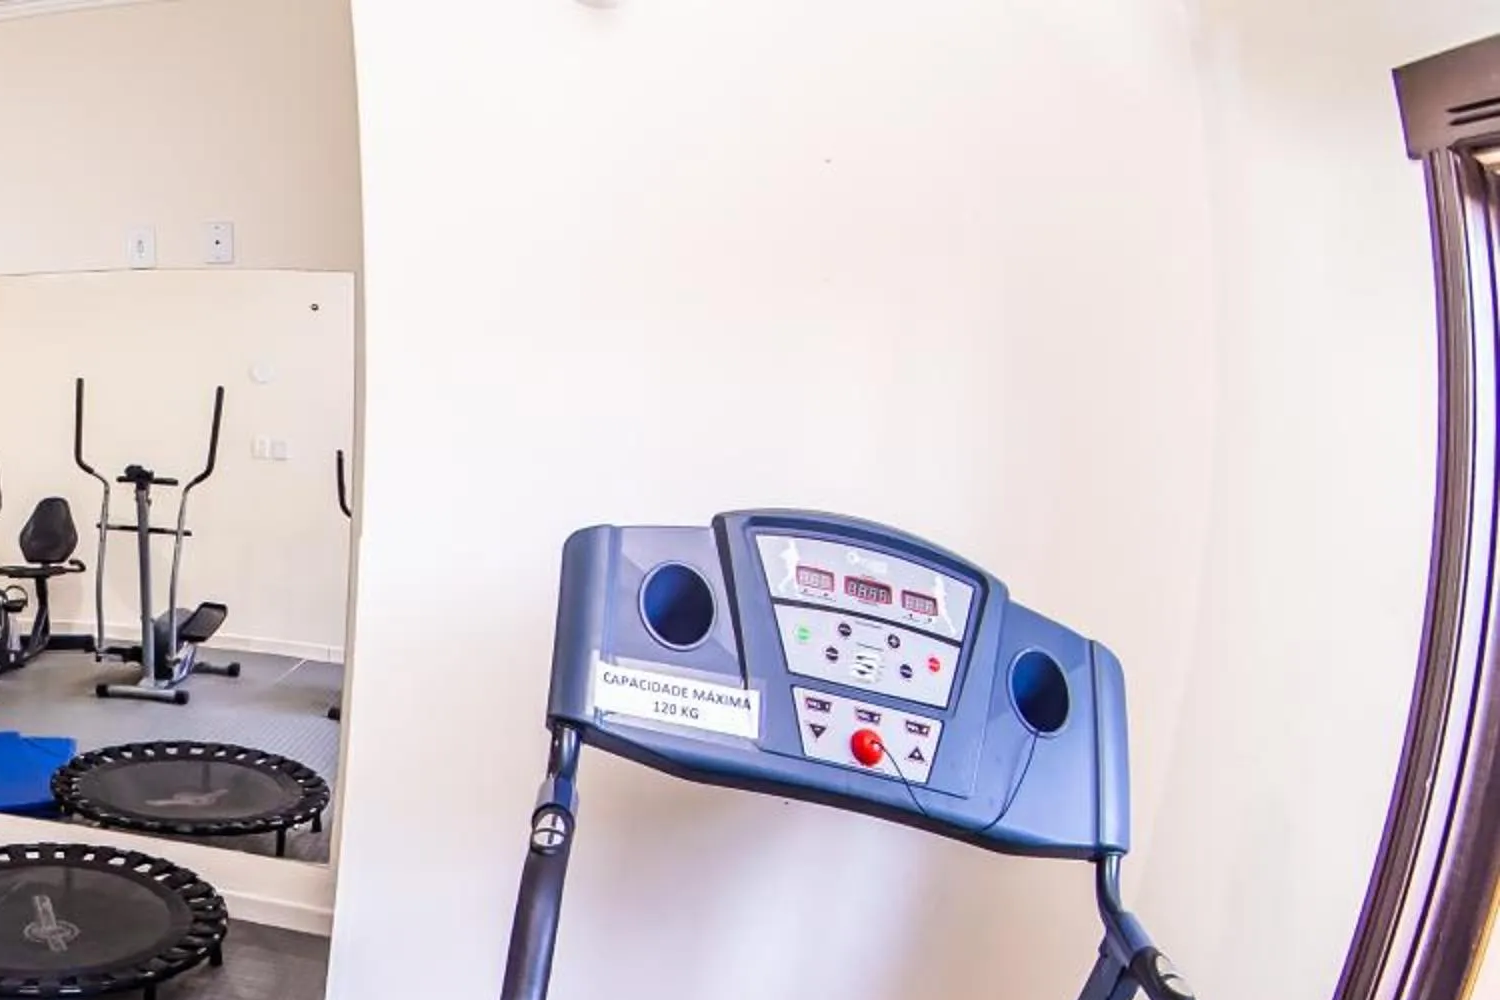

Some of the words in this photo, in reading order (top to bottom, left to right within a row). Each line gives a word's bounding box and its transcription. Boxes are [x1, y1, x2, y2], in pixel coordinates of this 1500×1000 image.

[603, 671, 688, 699] CAPACIDADE
[692, 688, 751, 711] MÁXIMA
[653, 701, 677, 715] 120
[680, 706, 699, 720] KG
